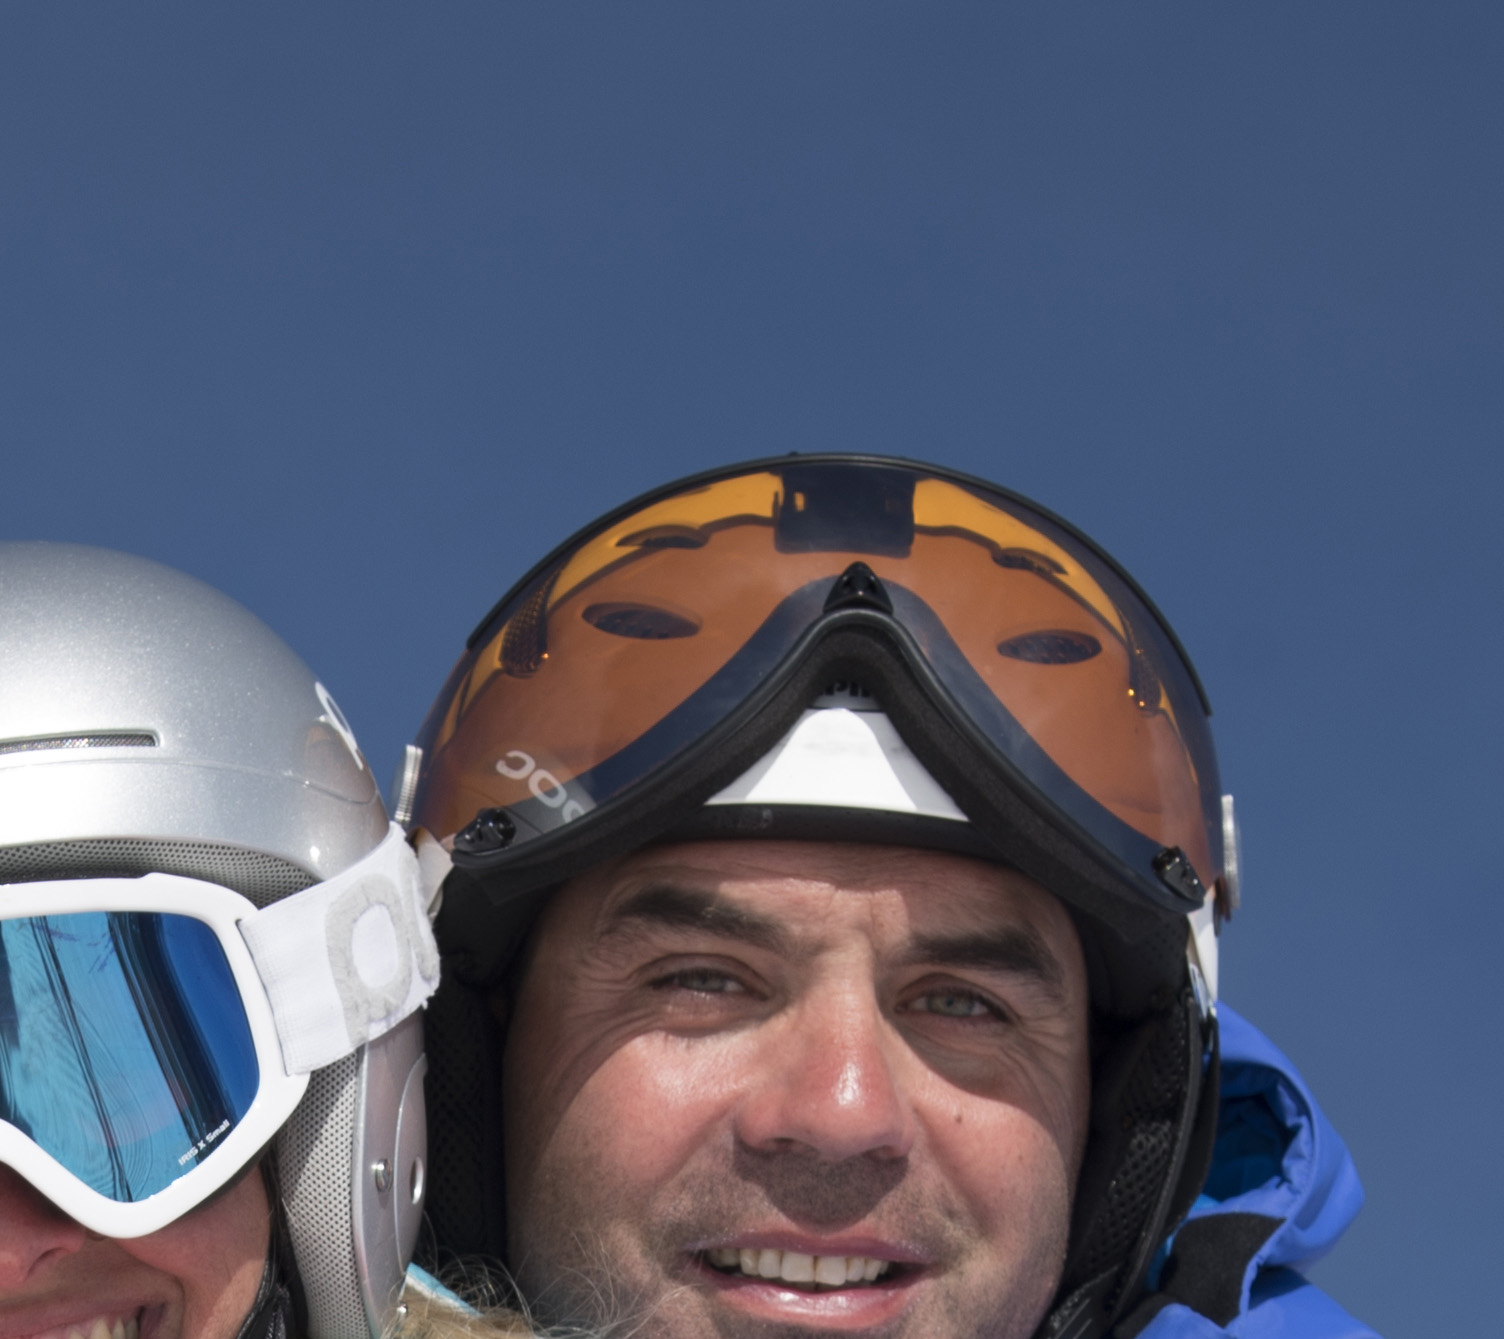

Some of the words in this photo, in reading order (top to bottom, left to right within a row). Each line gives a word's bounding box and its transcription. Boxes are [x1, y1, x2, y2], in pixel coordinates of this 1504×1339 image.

[178, 1146, 198, 1166] IRIS
[197, 1140, 206, 1150] X
[205, 1119, 230, 1143] Small
